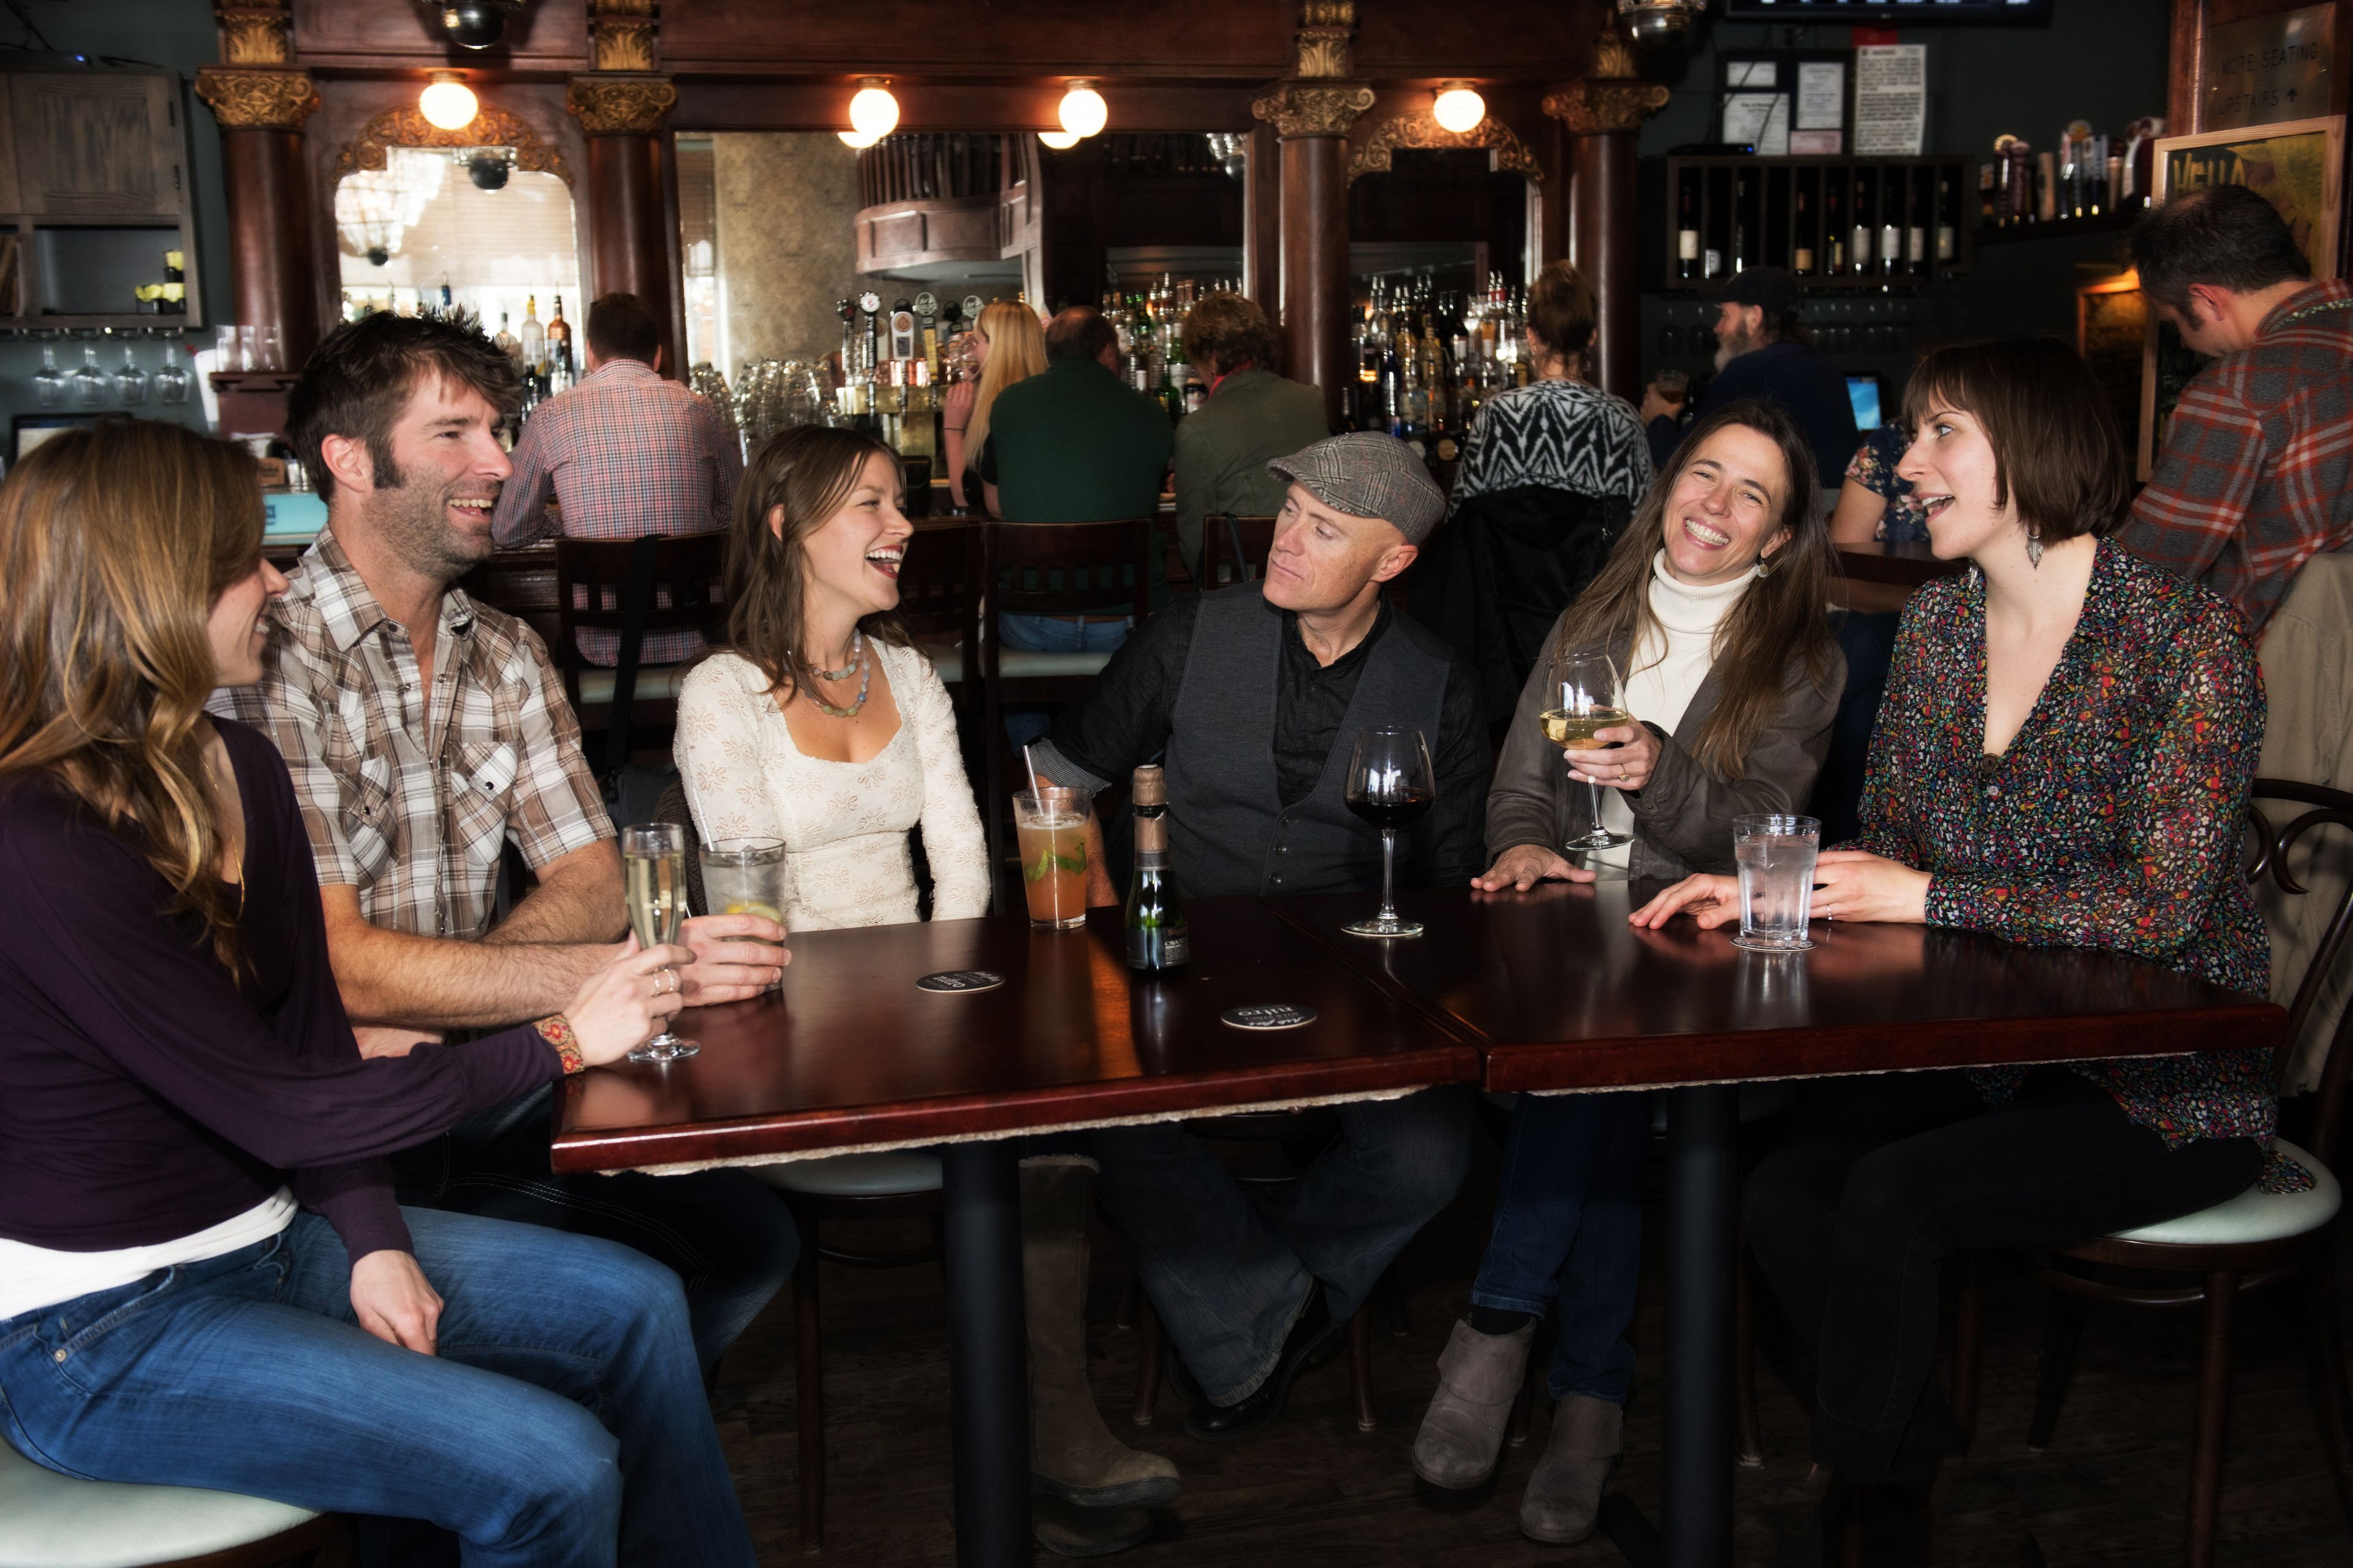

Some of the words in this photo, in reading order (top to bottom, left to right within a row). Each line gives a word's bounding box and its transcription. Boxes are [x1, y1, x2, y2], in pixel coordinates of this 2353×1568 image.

[2221, 53, 2254, 75] MORE
[2261, 42, 2318, 69] SEATING
[2219, 89, 2278, 115] UPSTAIRS
[932, 975, 966, 988] nitro
[1238, 1007, 1294, 1016] nitro
